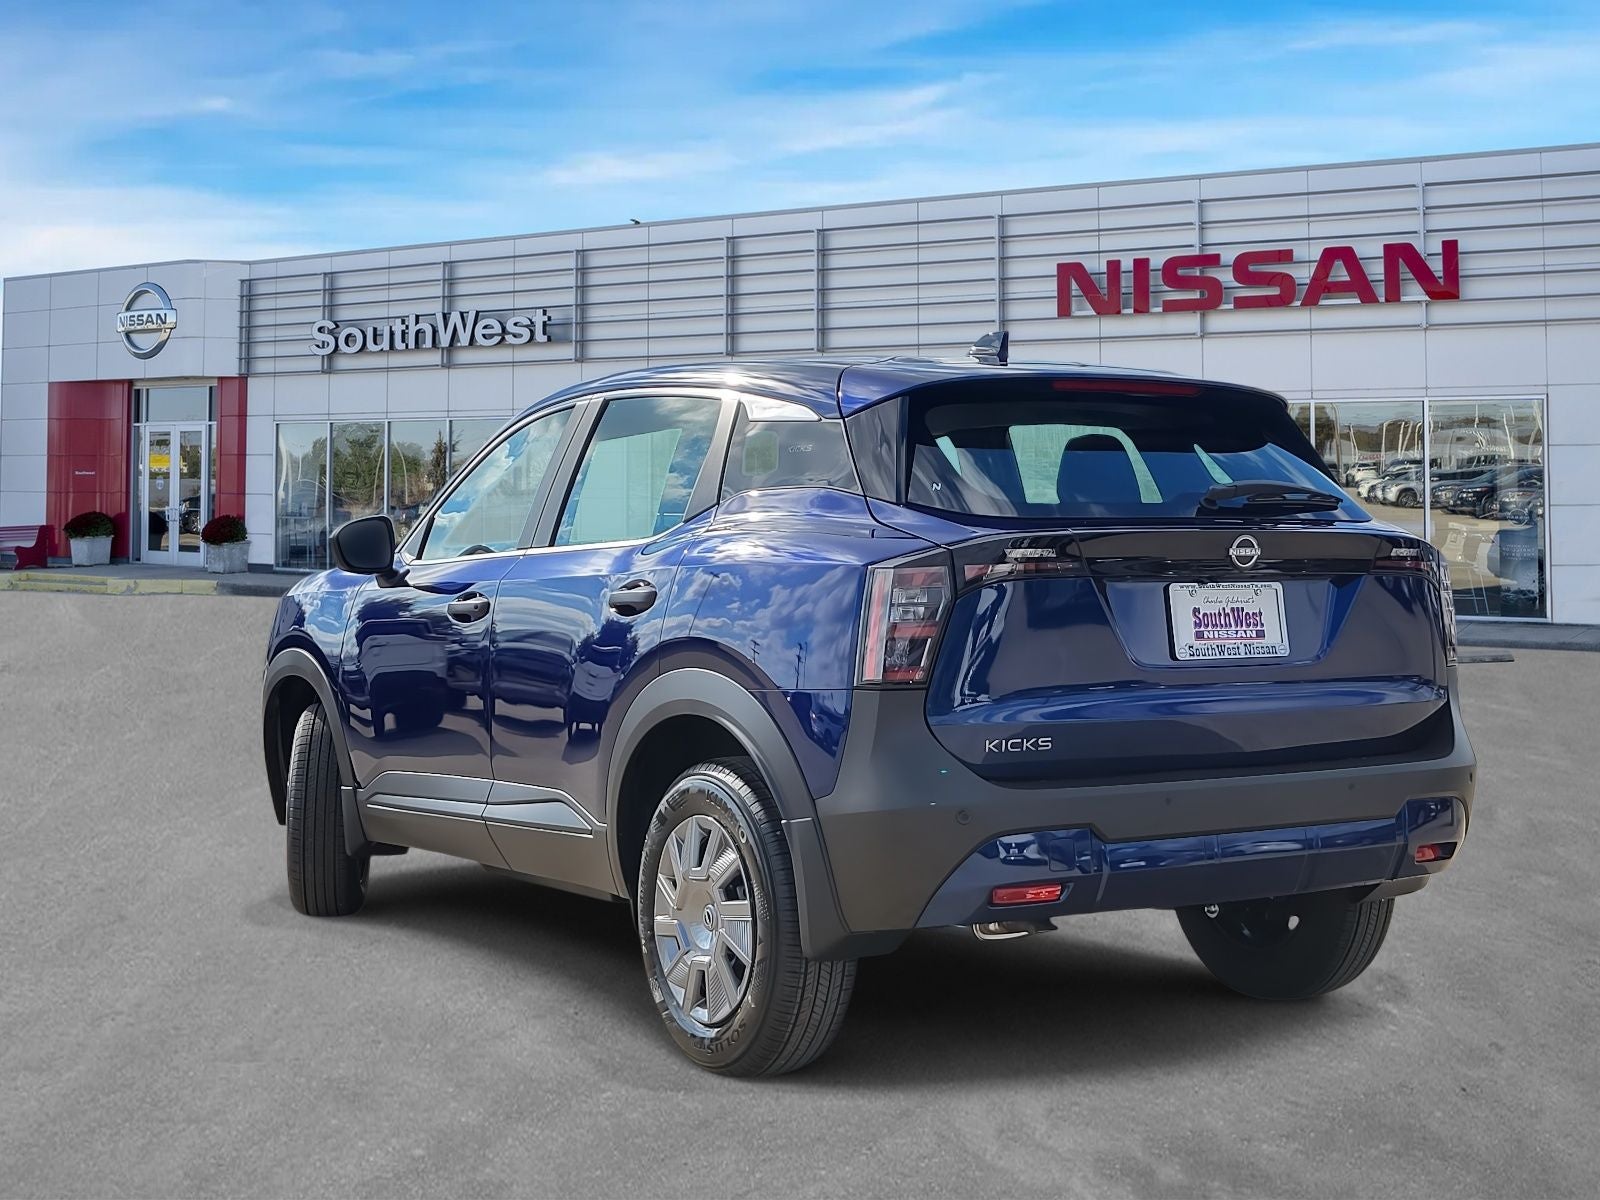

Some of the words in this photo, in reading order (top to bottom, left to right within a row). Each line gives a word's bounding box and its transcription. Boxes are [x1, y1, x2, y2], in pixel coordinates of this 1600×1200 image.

[1056, 239, 1461, 318] NISSAN
[119, 312, 168, 328] NISSAN
[309, 308, 551, 356] SouthWest
[1230, 547, 1261, 556] NISSAN
[1191, 606, 1265, 630] SouthWest
[1203, 630, 1257, 638] NISSAN
[1188, 643, 1241, 657] SouthWest
[1244, 642, 1278, 656] Nissan
[985, 737, 1052, 753] KICKS
